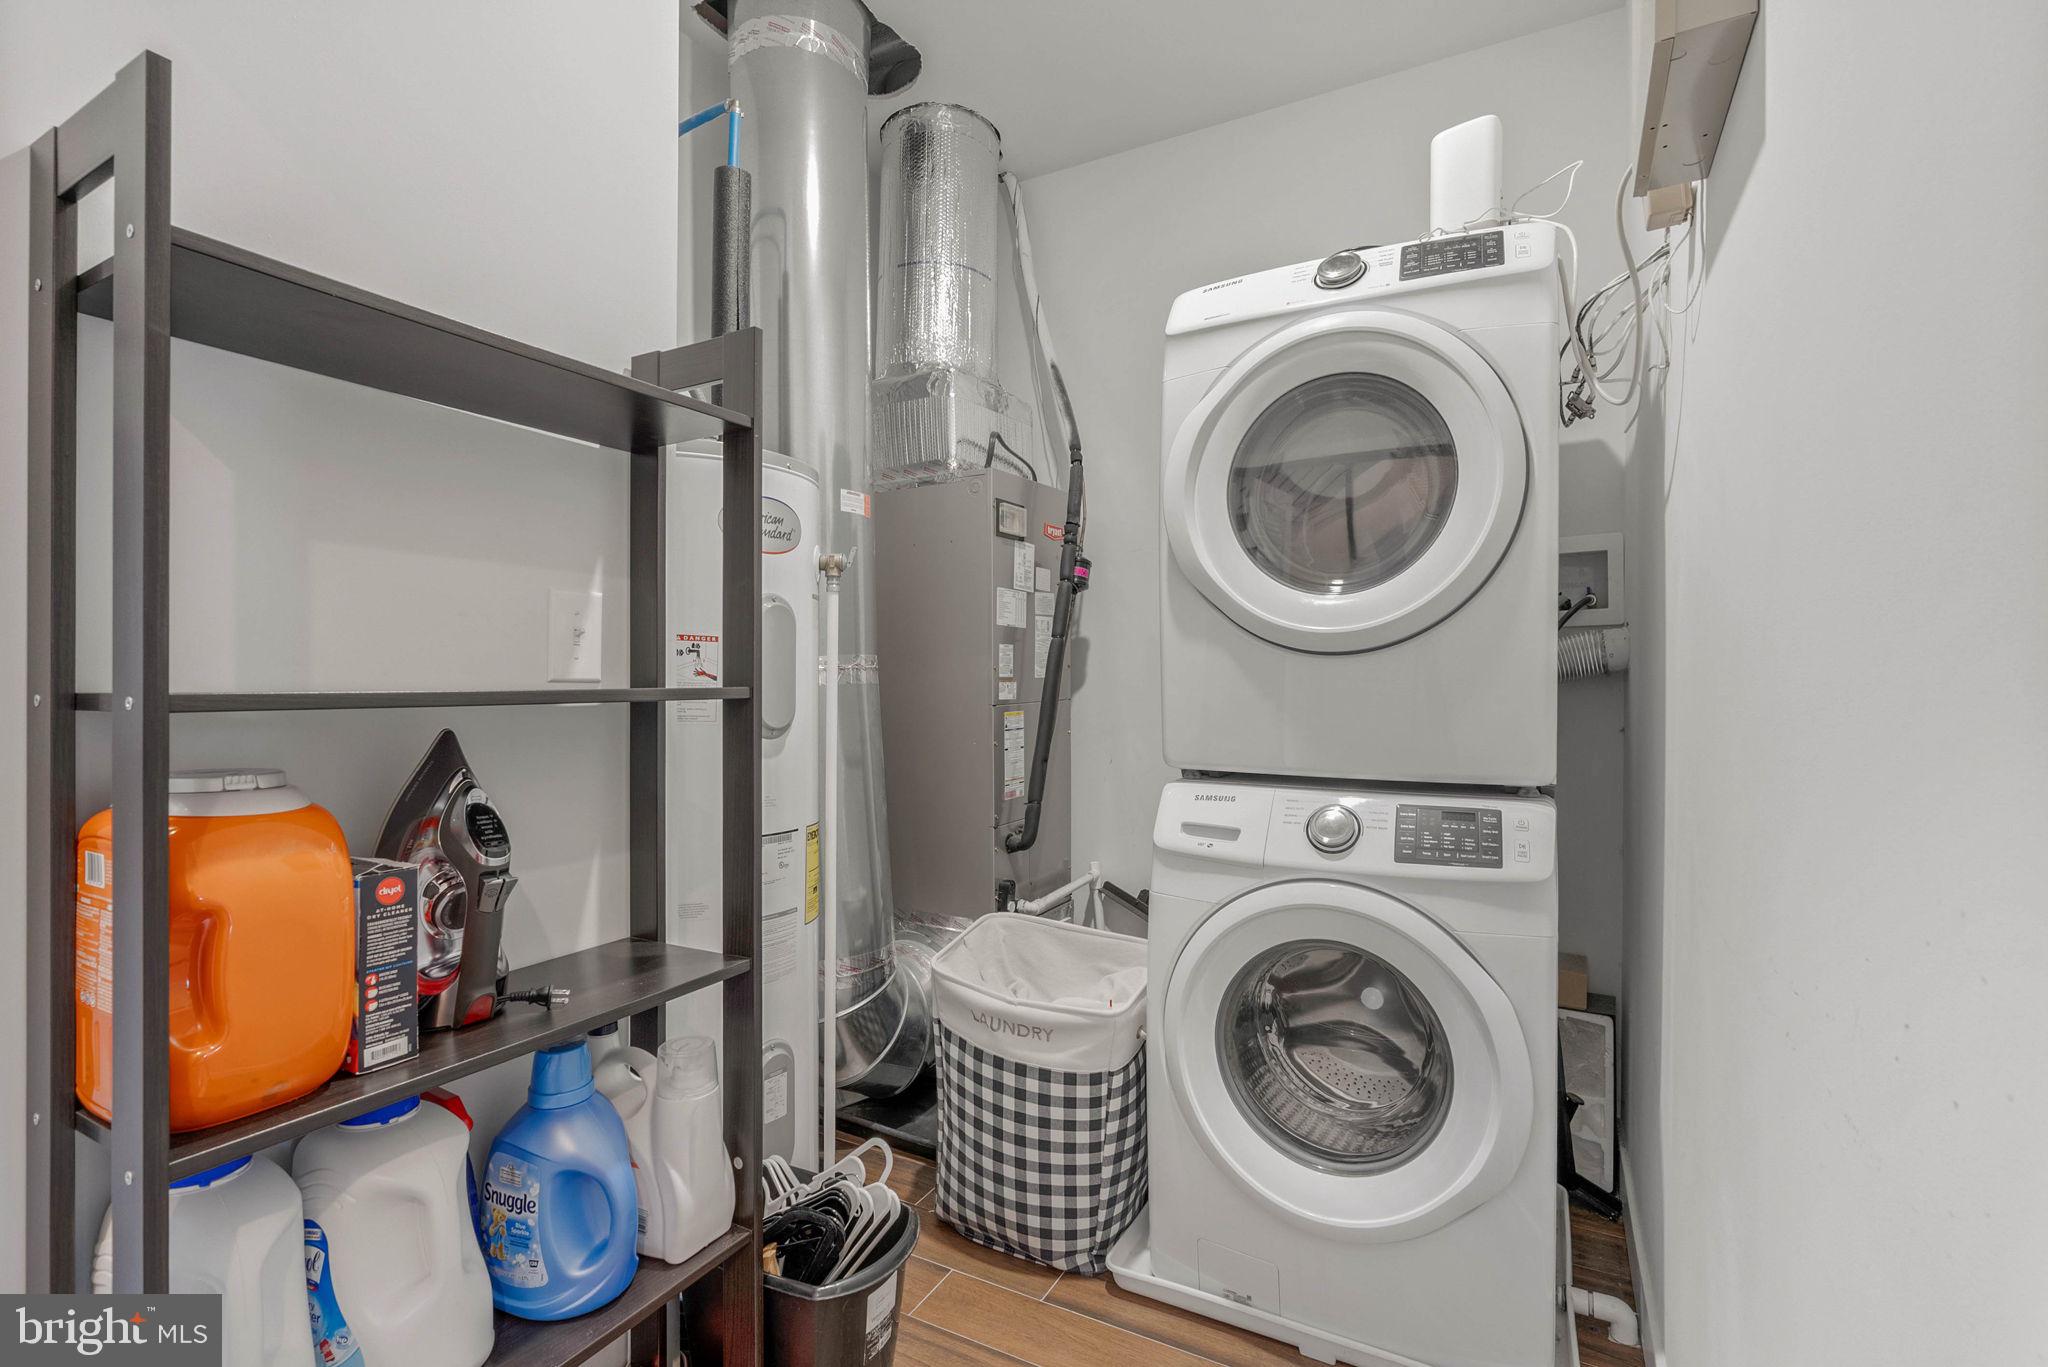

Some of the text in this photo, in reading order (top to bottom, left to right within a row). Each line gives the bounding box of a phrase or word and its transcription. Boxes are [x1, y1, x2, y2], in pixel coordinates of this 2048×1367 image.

[1202, 279, 1244, 293] SAMSUNG
[1194, 794, 1237, 802] SAMSUNG
[970, 1009, 1054, 1043] LAUNDRY
[484, 1182, 536, 1215] Snuggle
